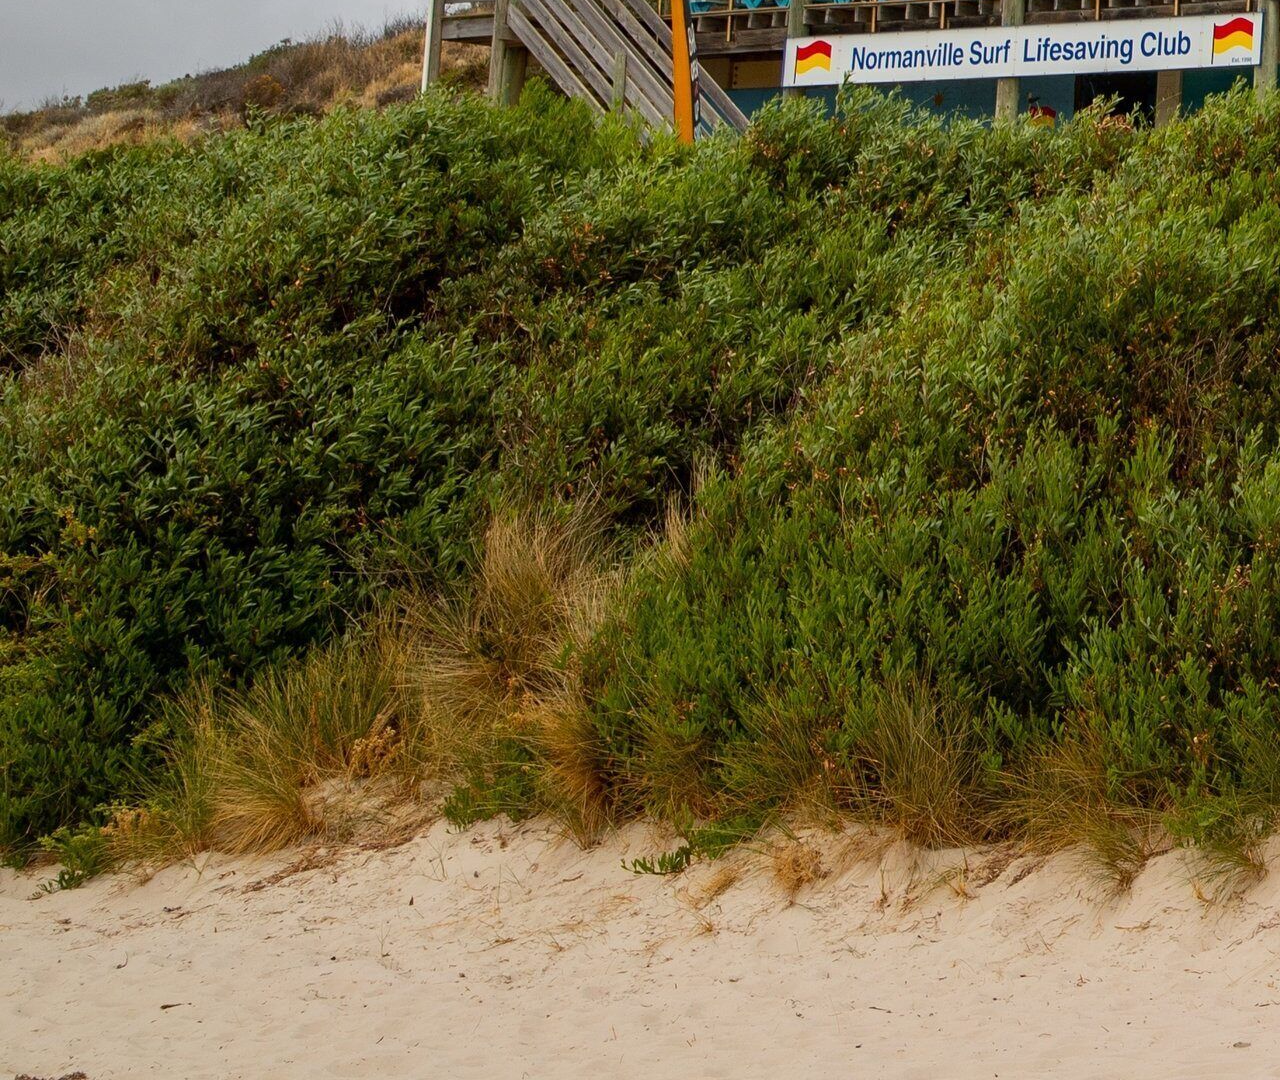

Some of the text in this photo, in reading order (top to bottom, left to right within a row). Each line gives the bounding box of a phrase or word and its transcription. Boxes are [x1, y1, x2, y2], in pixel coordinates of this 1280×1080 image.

[851, 30, 1191, 70] Normanville Surf Lifesaving Club
